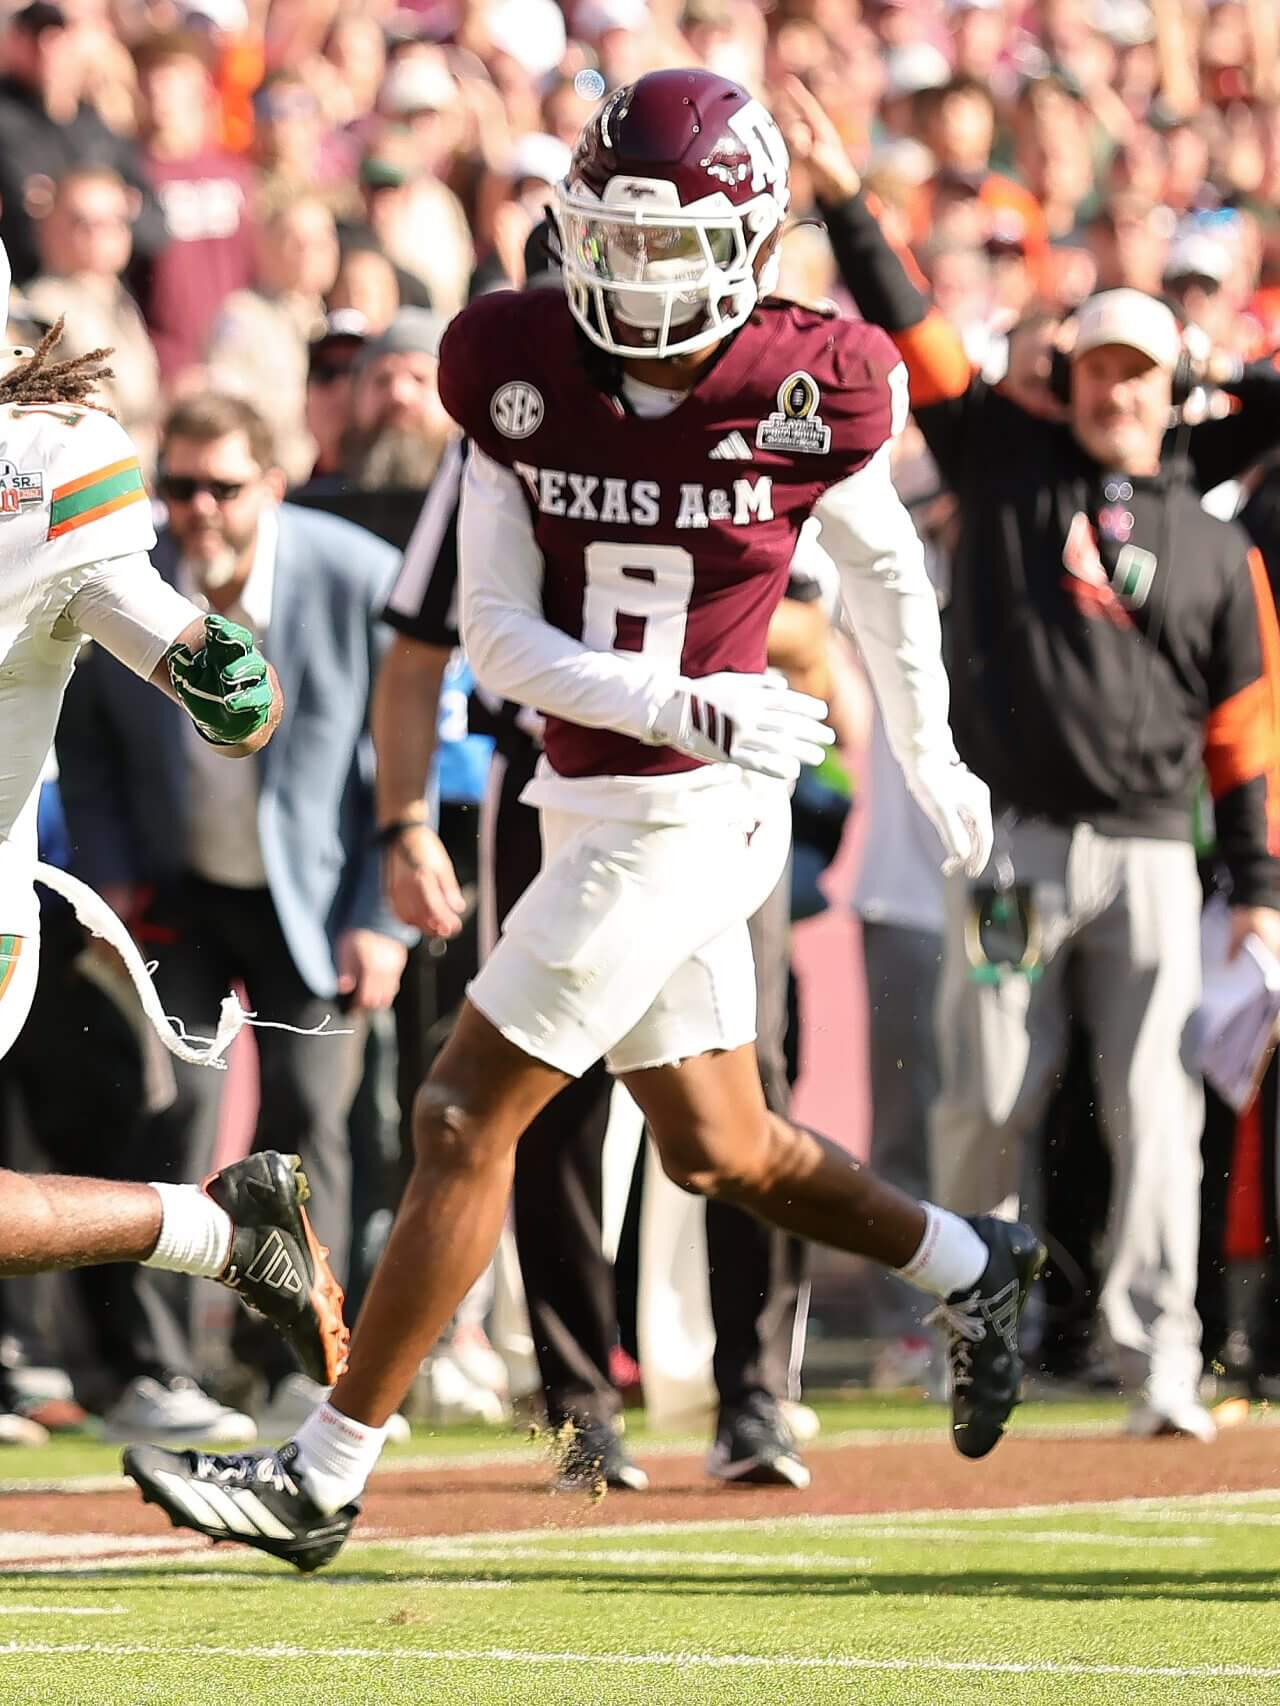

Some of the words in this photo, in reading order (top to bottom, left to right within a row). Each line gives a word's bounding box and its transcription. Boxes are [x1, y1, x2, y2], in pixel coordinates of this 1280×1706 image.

[495, 387, 540, 433] SEC
[12, 476, 36, 488] SR.
[675, 475, 774, 528] A&M
[582, 541, 695, 678] 8
